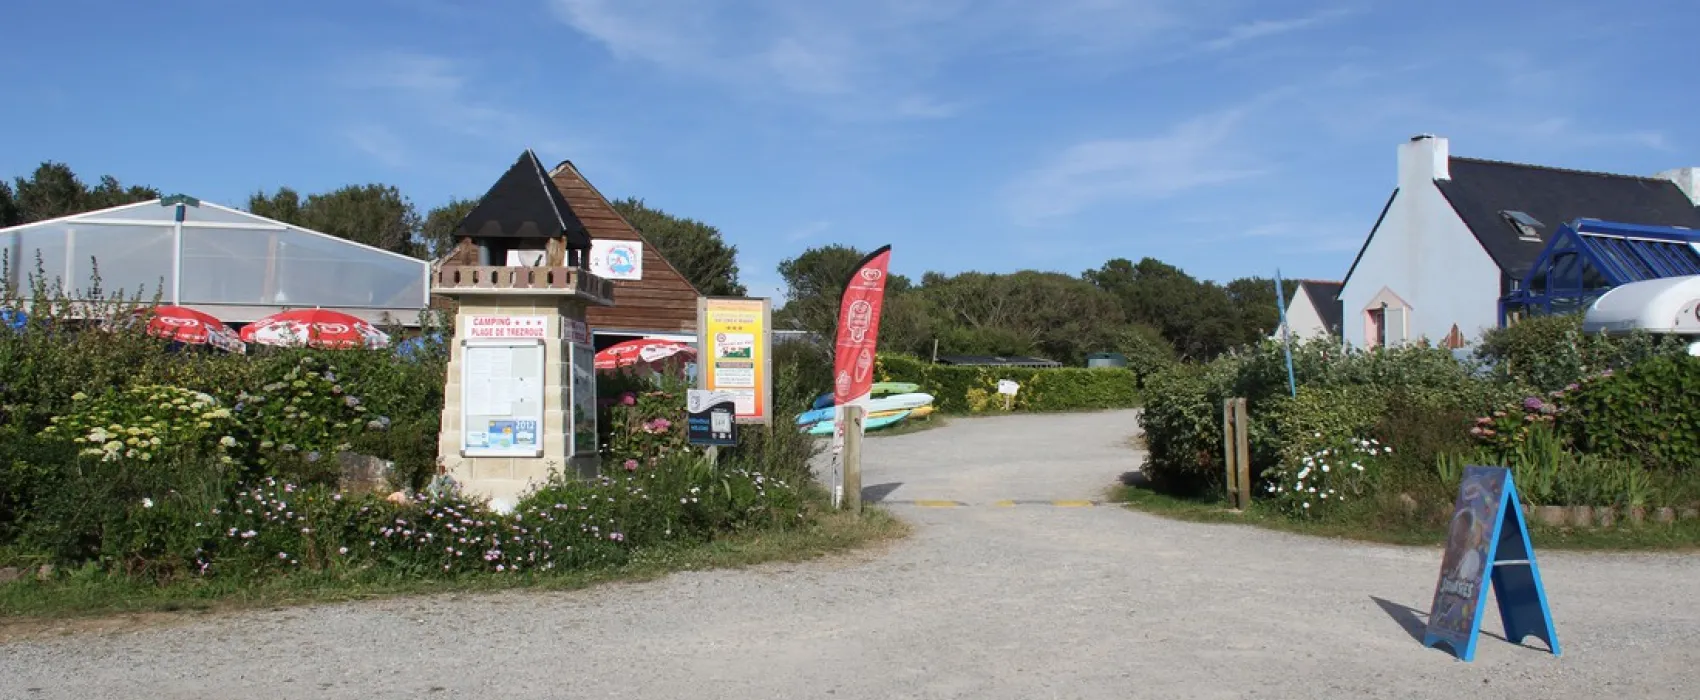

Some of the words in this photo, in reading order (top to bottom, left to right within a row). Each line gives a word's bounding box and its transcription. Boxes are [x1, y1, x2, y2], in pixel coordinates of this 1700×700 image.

[473, 317, 511, 326] CAMPING
[471, 328, 493, 336] PLAGE
[496, 328, 504, 336] DE
[515, 420, 535, 430] 2012
